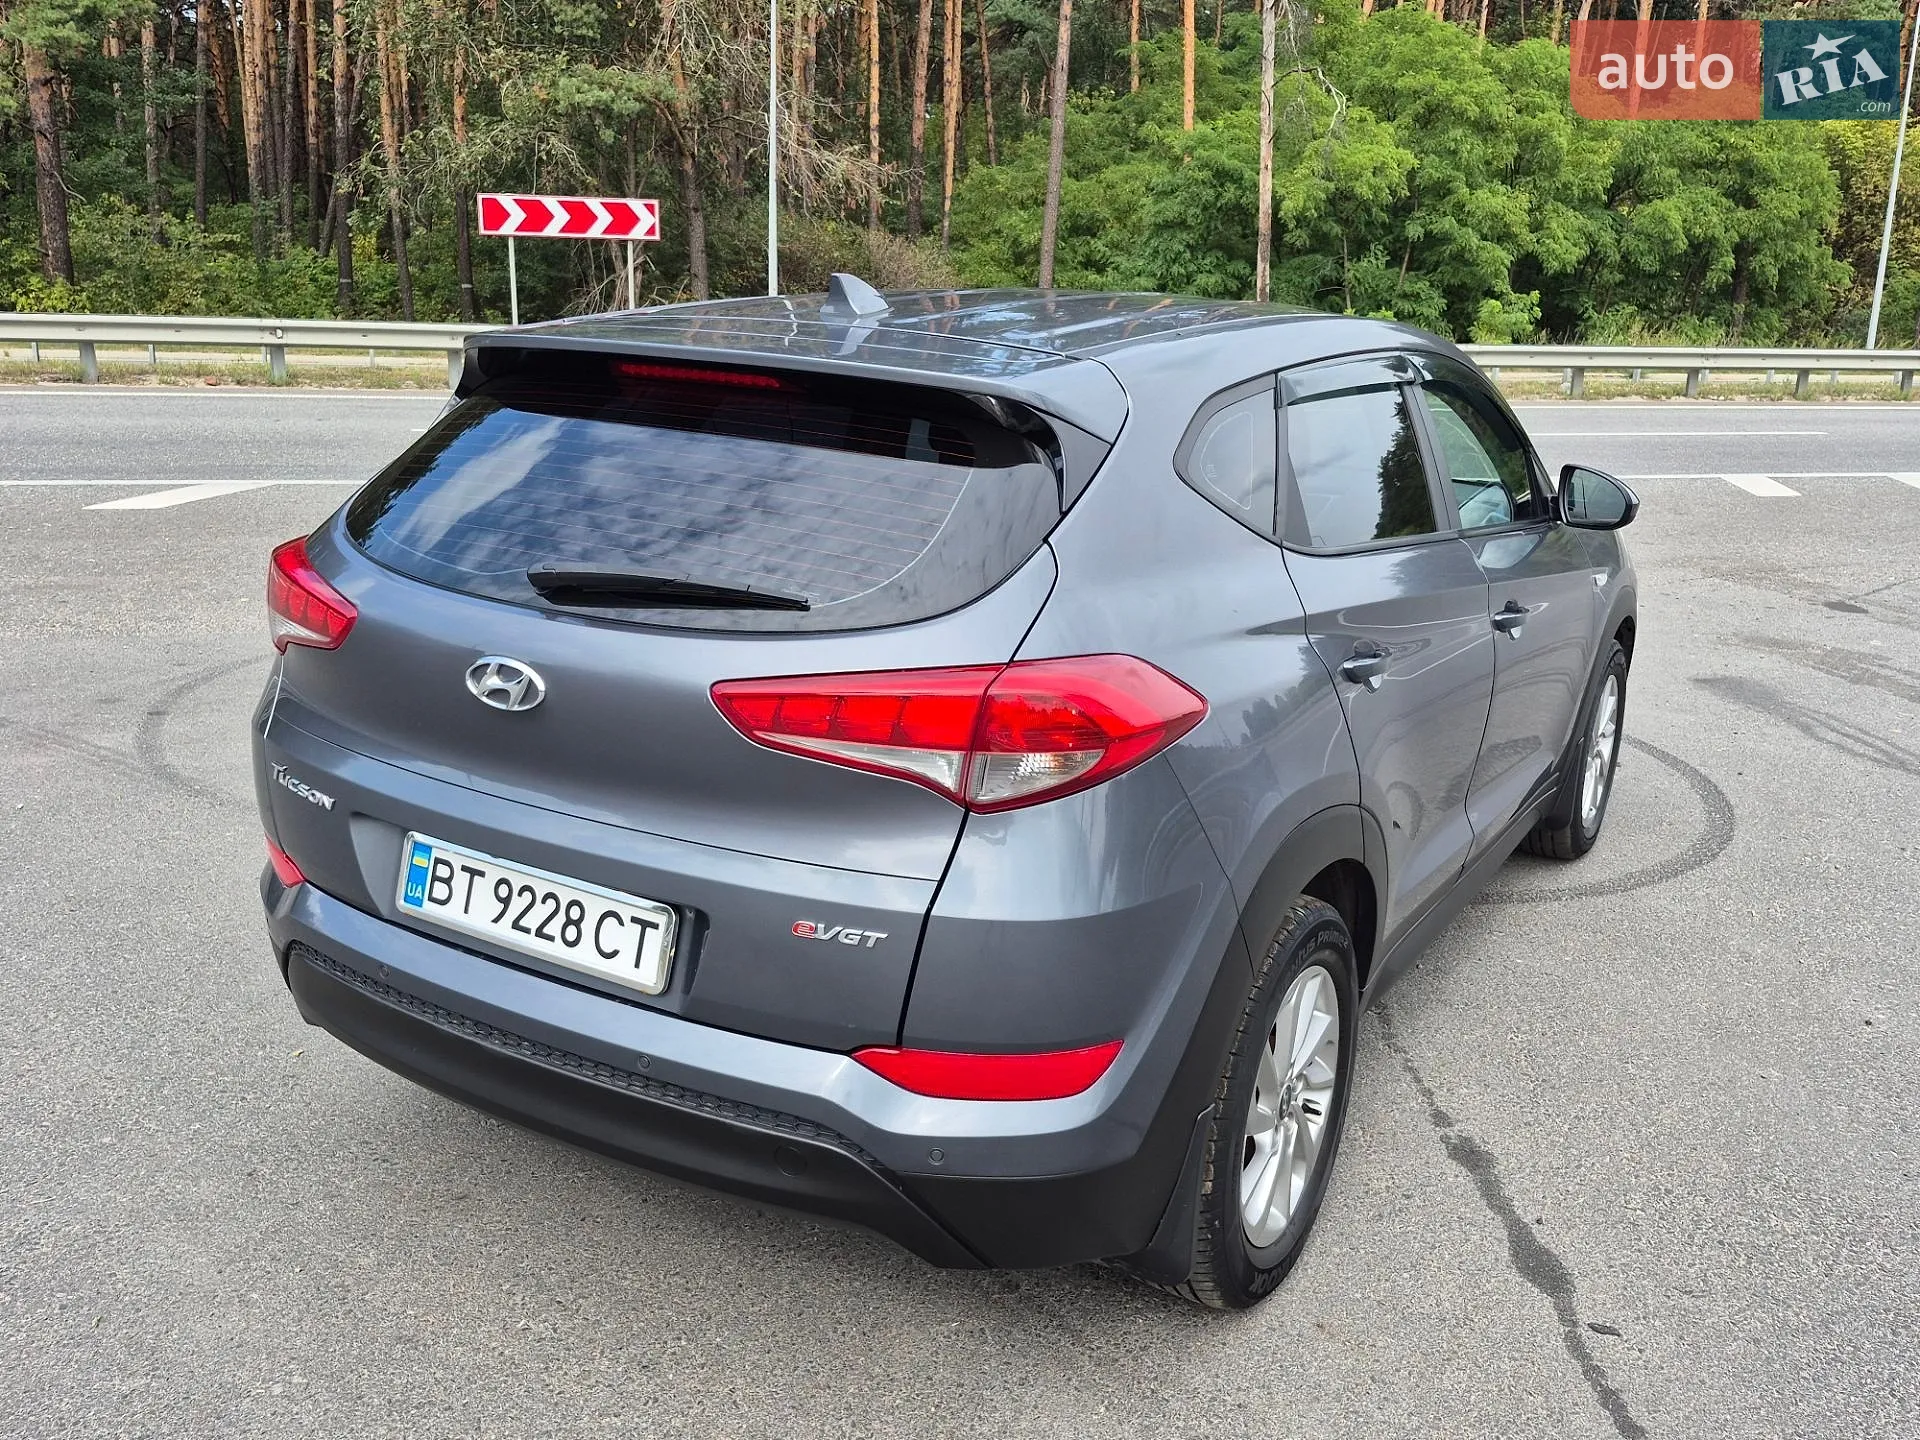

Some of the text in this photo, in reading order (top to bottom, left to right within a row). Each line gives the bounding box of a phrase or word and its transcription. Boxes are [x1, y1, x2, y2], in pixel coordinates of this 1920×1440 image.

[407, 881, 423, 900] UA
[427, 856, 660, 970] BT 9228 CT
[791, 920, 889, 948] eVGT
